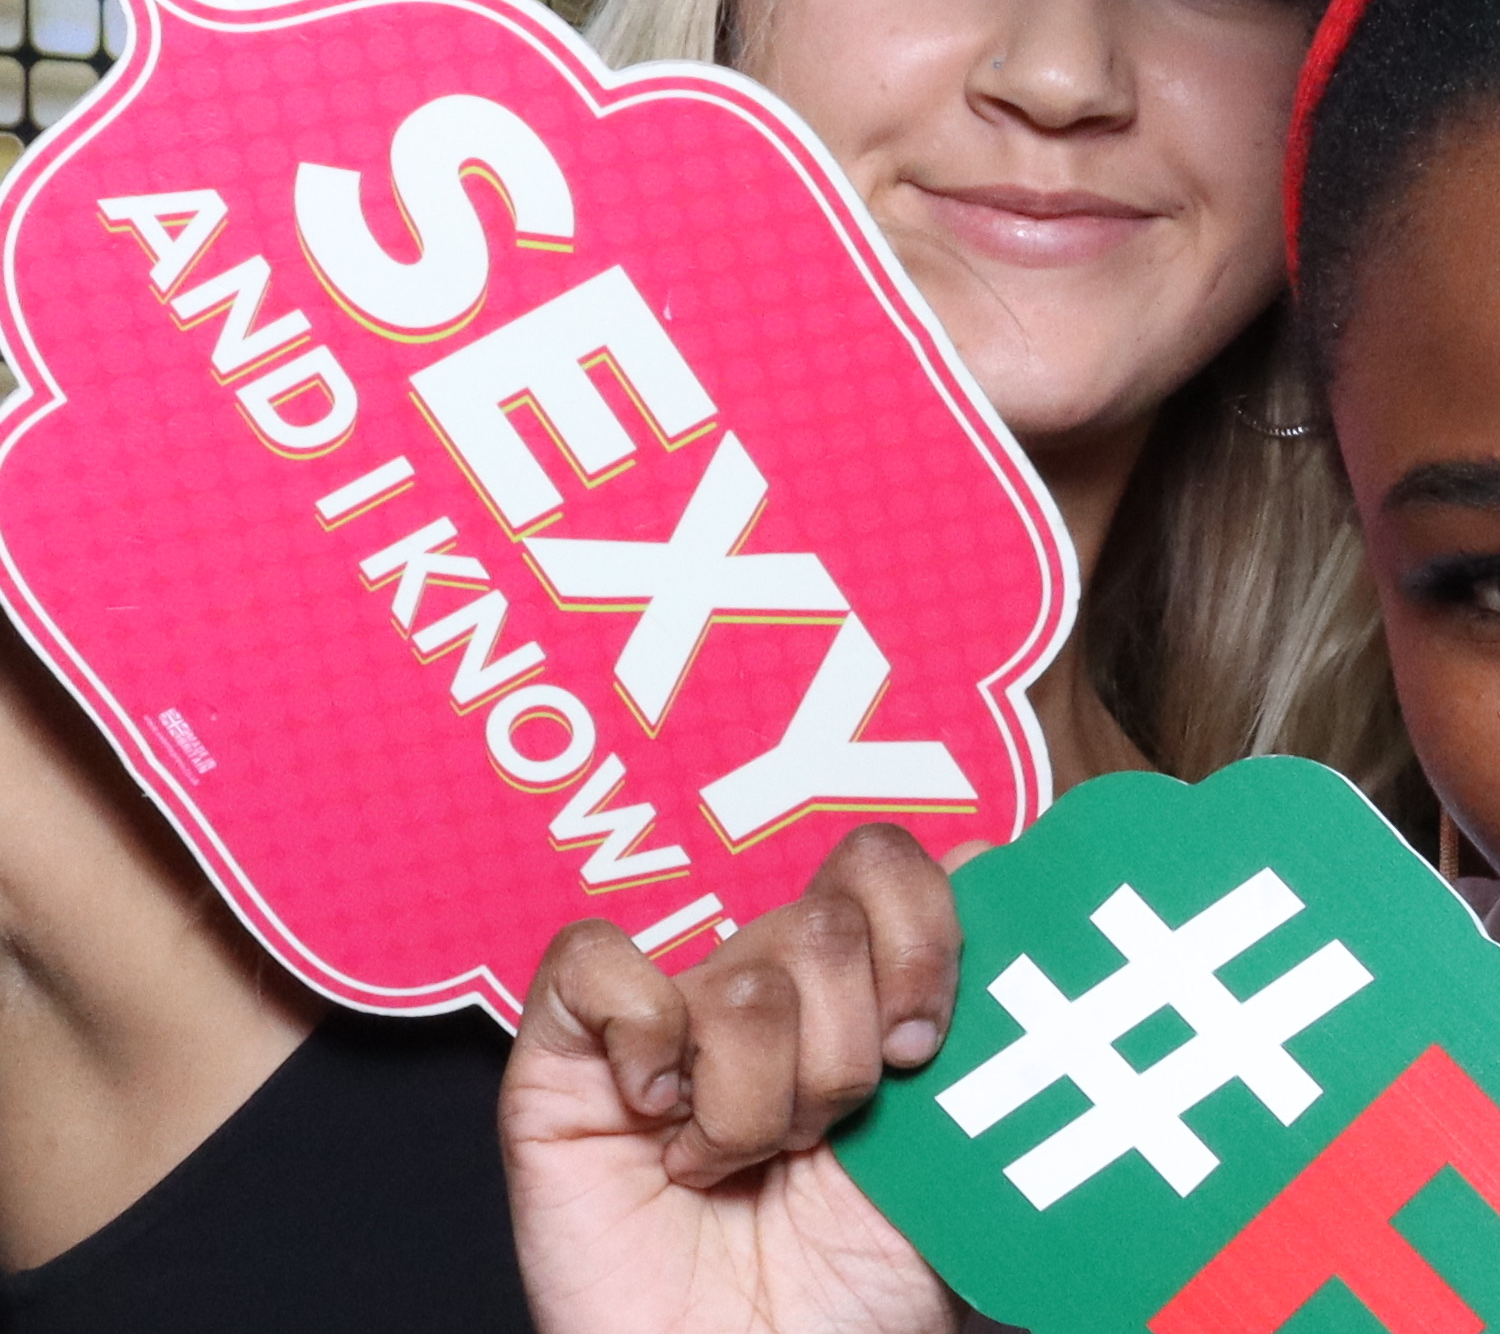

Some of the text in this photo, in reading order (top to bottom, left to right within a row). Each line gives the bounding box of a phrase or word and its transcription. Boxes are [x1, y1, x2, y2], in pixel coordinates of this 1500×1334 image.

[96, 187, 358, 459] AND
[293, 93, 980, 856] SEXY
[315, 456, 415, 532] I
[358, 516, 691, 894] KNOW
